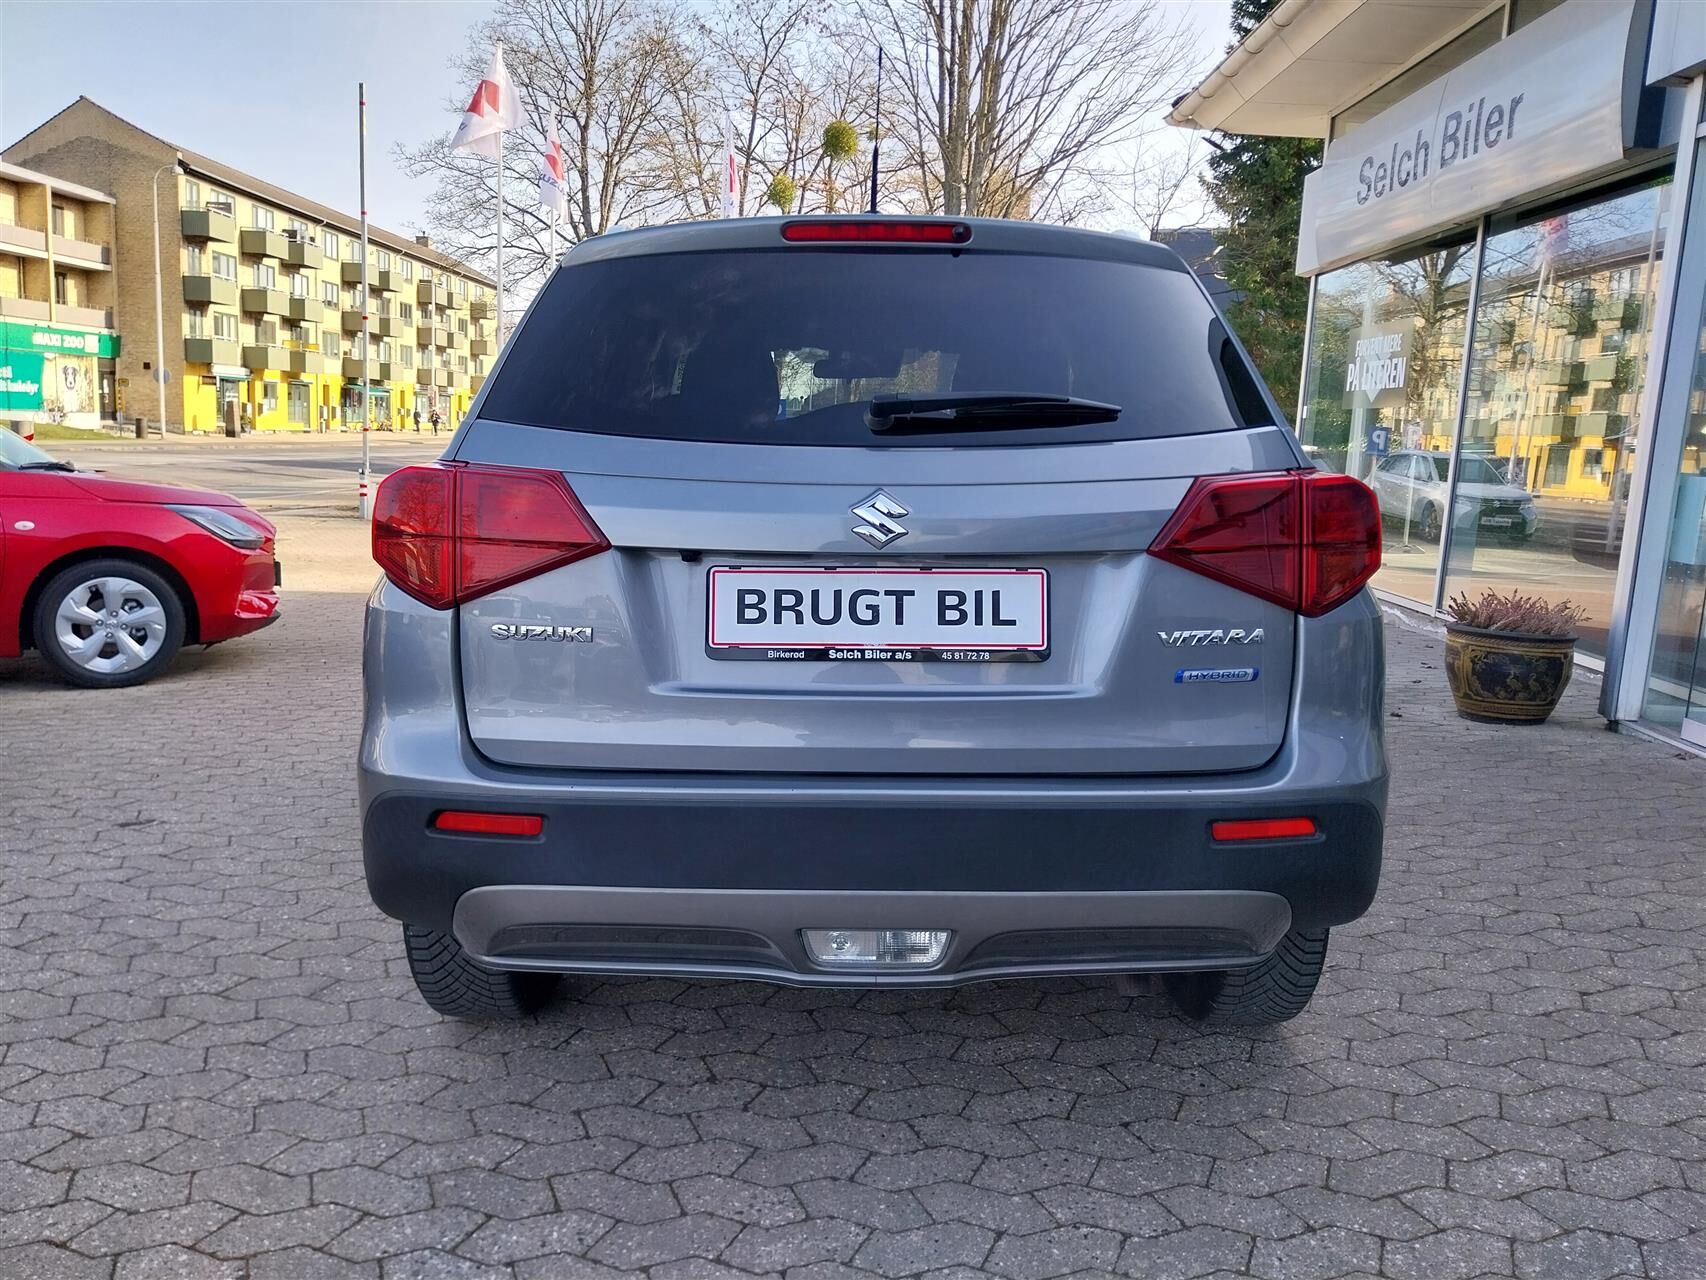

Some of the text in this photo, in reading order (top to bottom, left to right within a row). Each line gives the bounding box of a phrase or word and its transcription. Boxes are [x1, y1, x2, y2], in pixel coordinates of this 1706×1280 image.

[1356, 93, 1525, 206] Selch Biler
[63, 334, 85, 349] ZOO
[1346, 357, 1360, 391] PÅ
[735, 588, 1018, 627] BRUGT BIL
[490, 624, 594, 643] SUZUKI
[1157, 628, 1265, 648] VITARA
[828, 649, 861, 659] Selch
[864, 649, 893, 659] Biler
[895, 650, 912, 660] a/s
[941, 651, 953, 660] 45
[954, 651, 964, 660] 81
[966, 652, 978, 660] 72
[979, 652, 990, 660] 78
[1188, 671, 1249, 682] HYBRID
